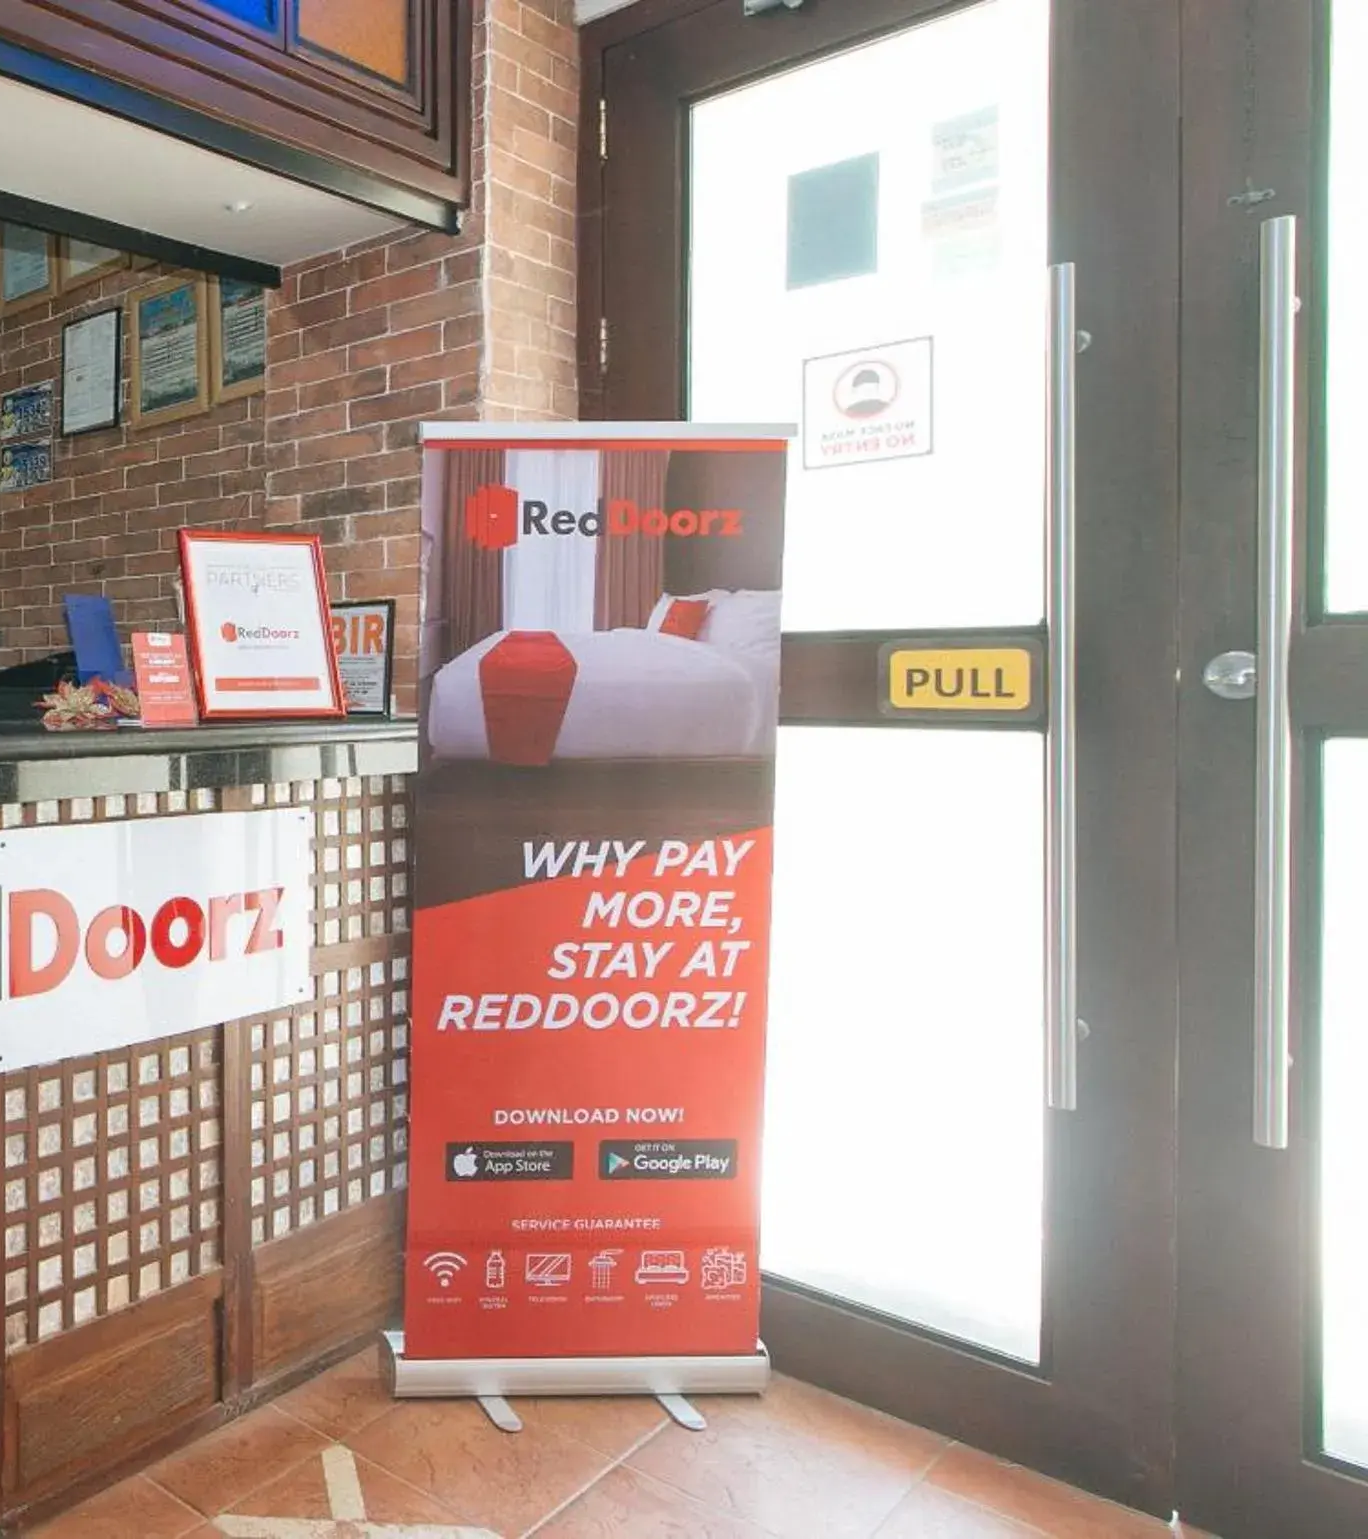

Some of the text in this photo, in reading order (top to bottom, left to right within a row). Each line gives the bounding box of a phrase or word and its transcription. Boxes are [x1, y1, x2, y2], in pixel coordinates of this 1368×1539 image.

[522, 497, 743, 537] RedDoorz
[906, 668, 1015, 697] PULL
[523, 839, 756, 879] WHY PAY
[582, 891, 743, 934] MORE,
[547, 941, 750, 980] STAY AT
[437, 992, 748, 1031] REDDOORZ!
[494, 1107, 685, 1125] DOWNLOAD NOW!
[484, 1159, 551, 1175] App Store
[634, 1153, 730, 1174] Google Play
[511, 1217, 662, 1231] SERVICE GUARANTEE
